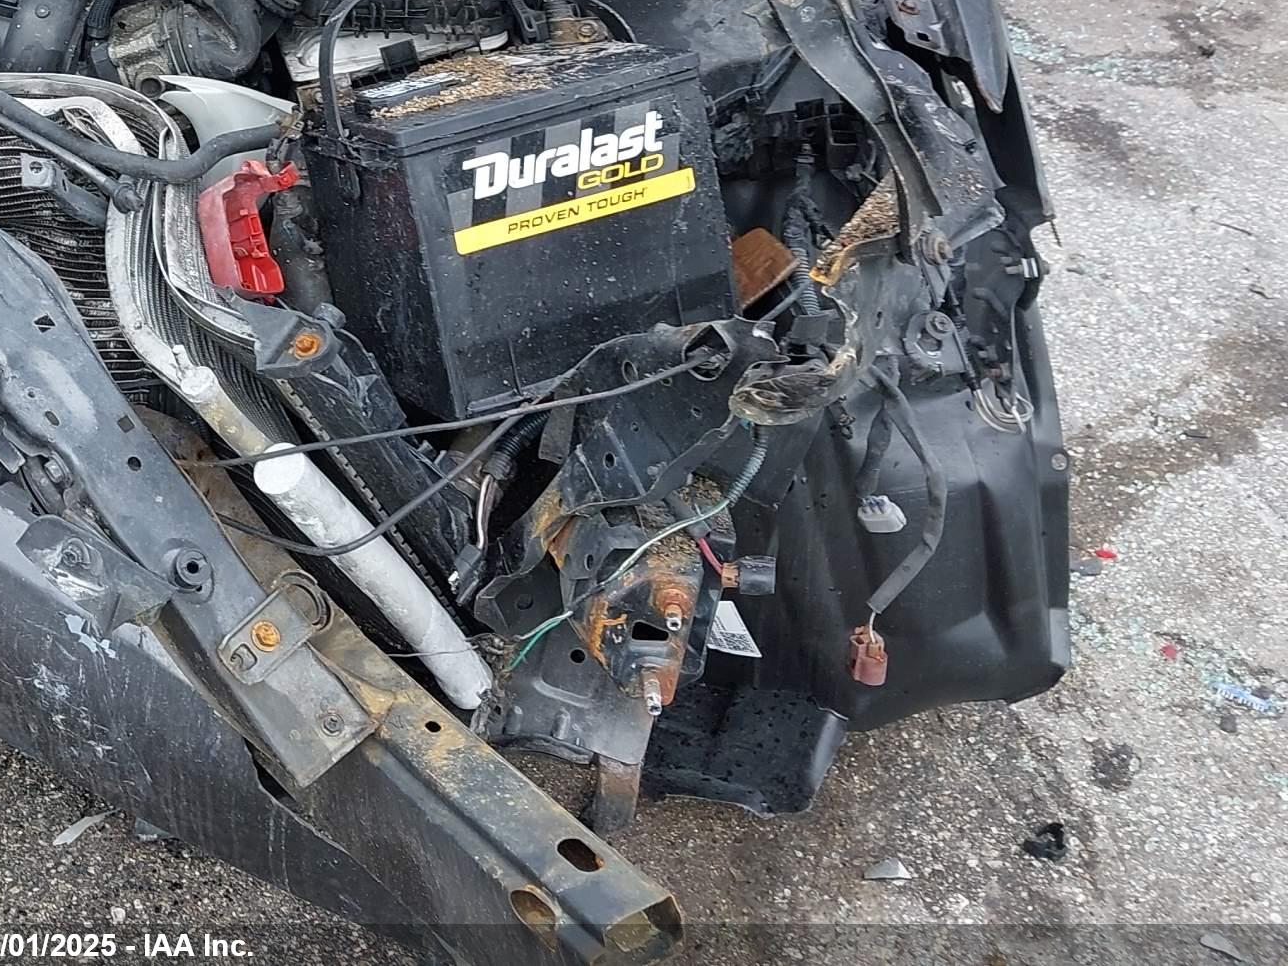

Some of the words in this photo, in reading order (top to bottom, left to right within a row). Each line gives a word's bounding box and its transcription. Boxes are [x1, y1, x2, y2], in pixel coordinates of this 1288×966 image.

[462, 110, 664, 200] Duralast
[577, 153, 664, 190] GOLD
[507, 205, 580, 235] PROVEN
[586, 187, 646, 213] TOUGH
